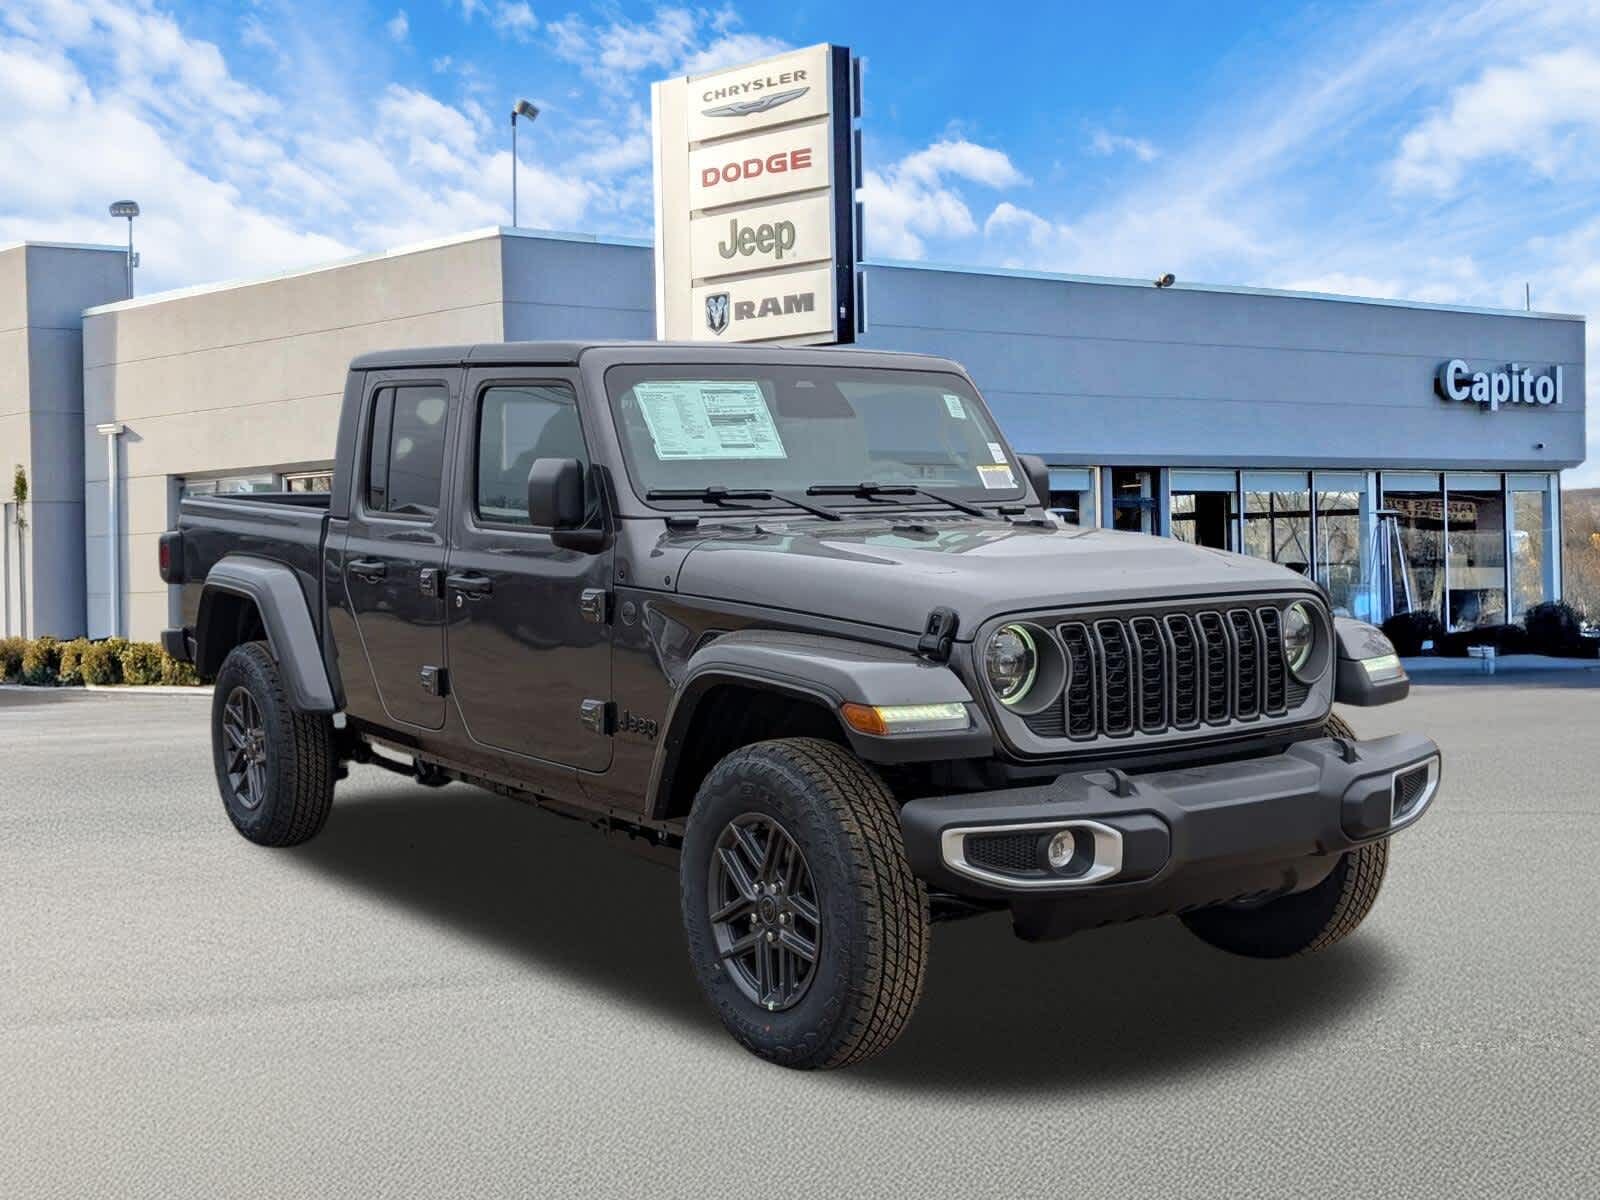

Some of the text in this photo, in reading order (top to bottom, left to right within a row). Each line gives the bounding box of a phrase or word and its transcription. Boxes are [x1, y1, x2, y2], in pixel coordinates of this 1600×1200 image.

[702, 70, 807, 102] CHRYSLER
[702, 148, 812, 188] DODGE
[718, 218, 796, 259] Jeep
[734, 292, 815, 321] RAM
[1445, 359, 1564, 411] Capitol
